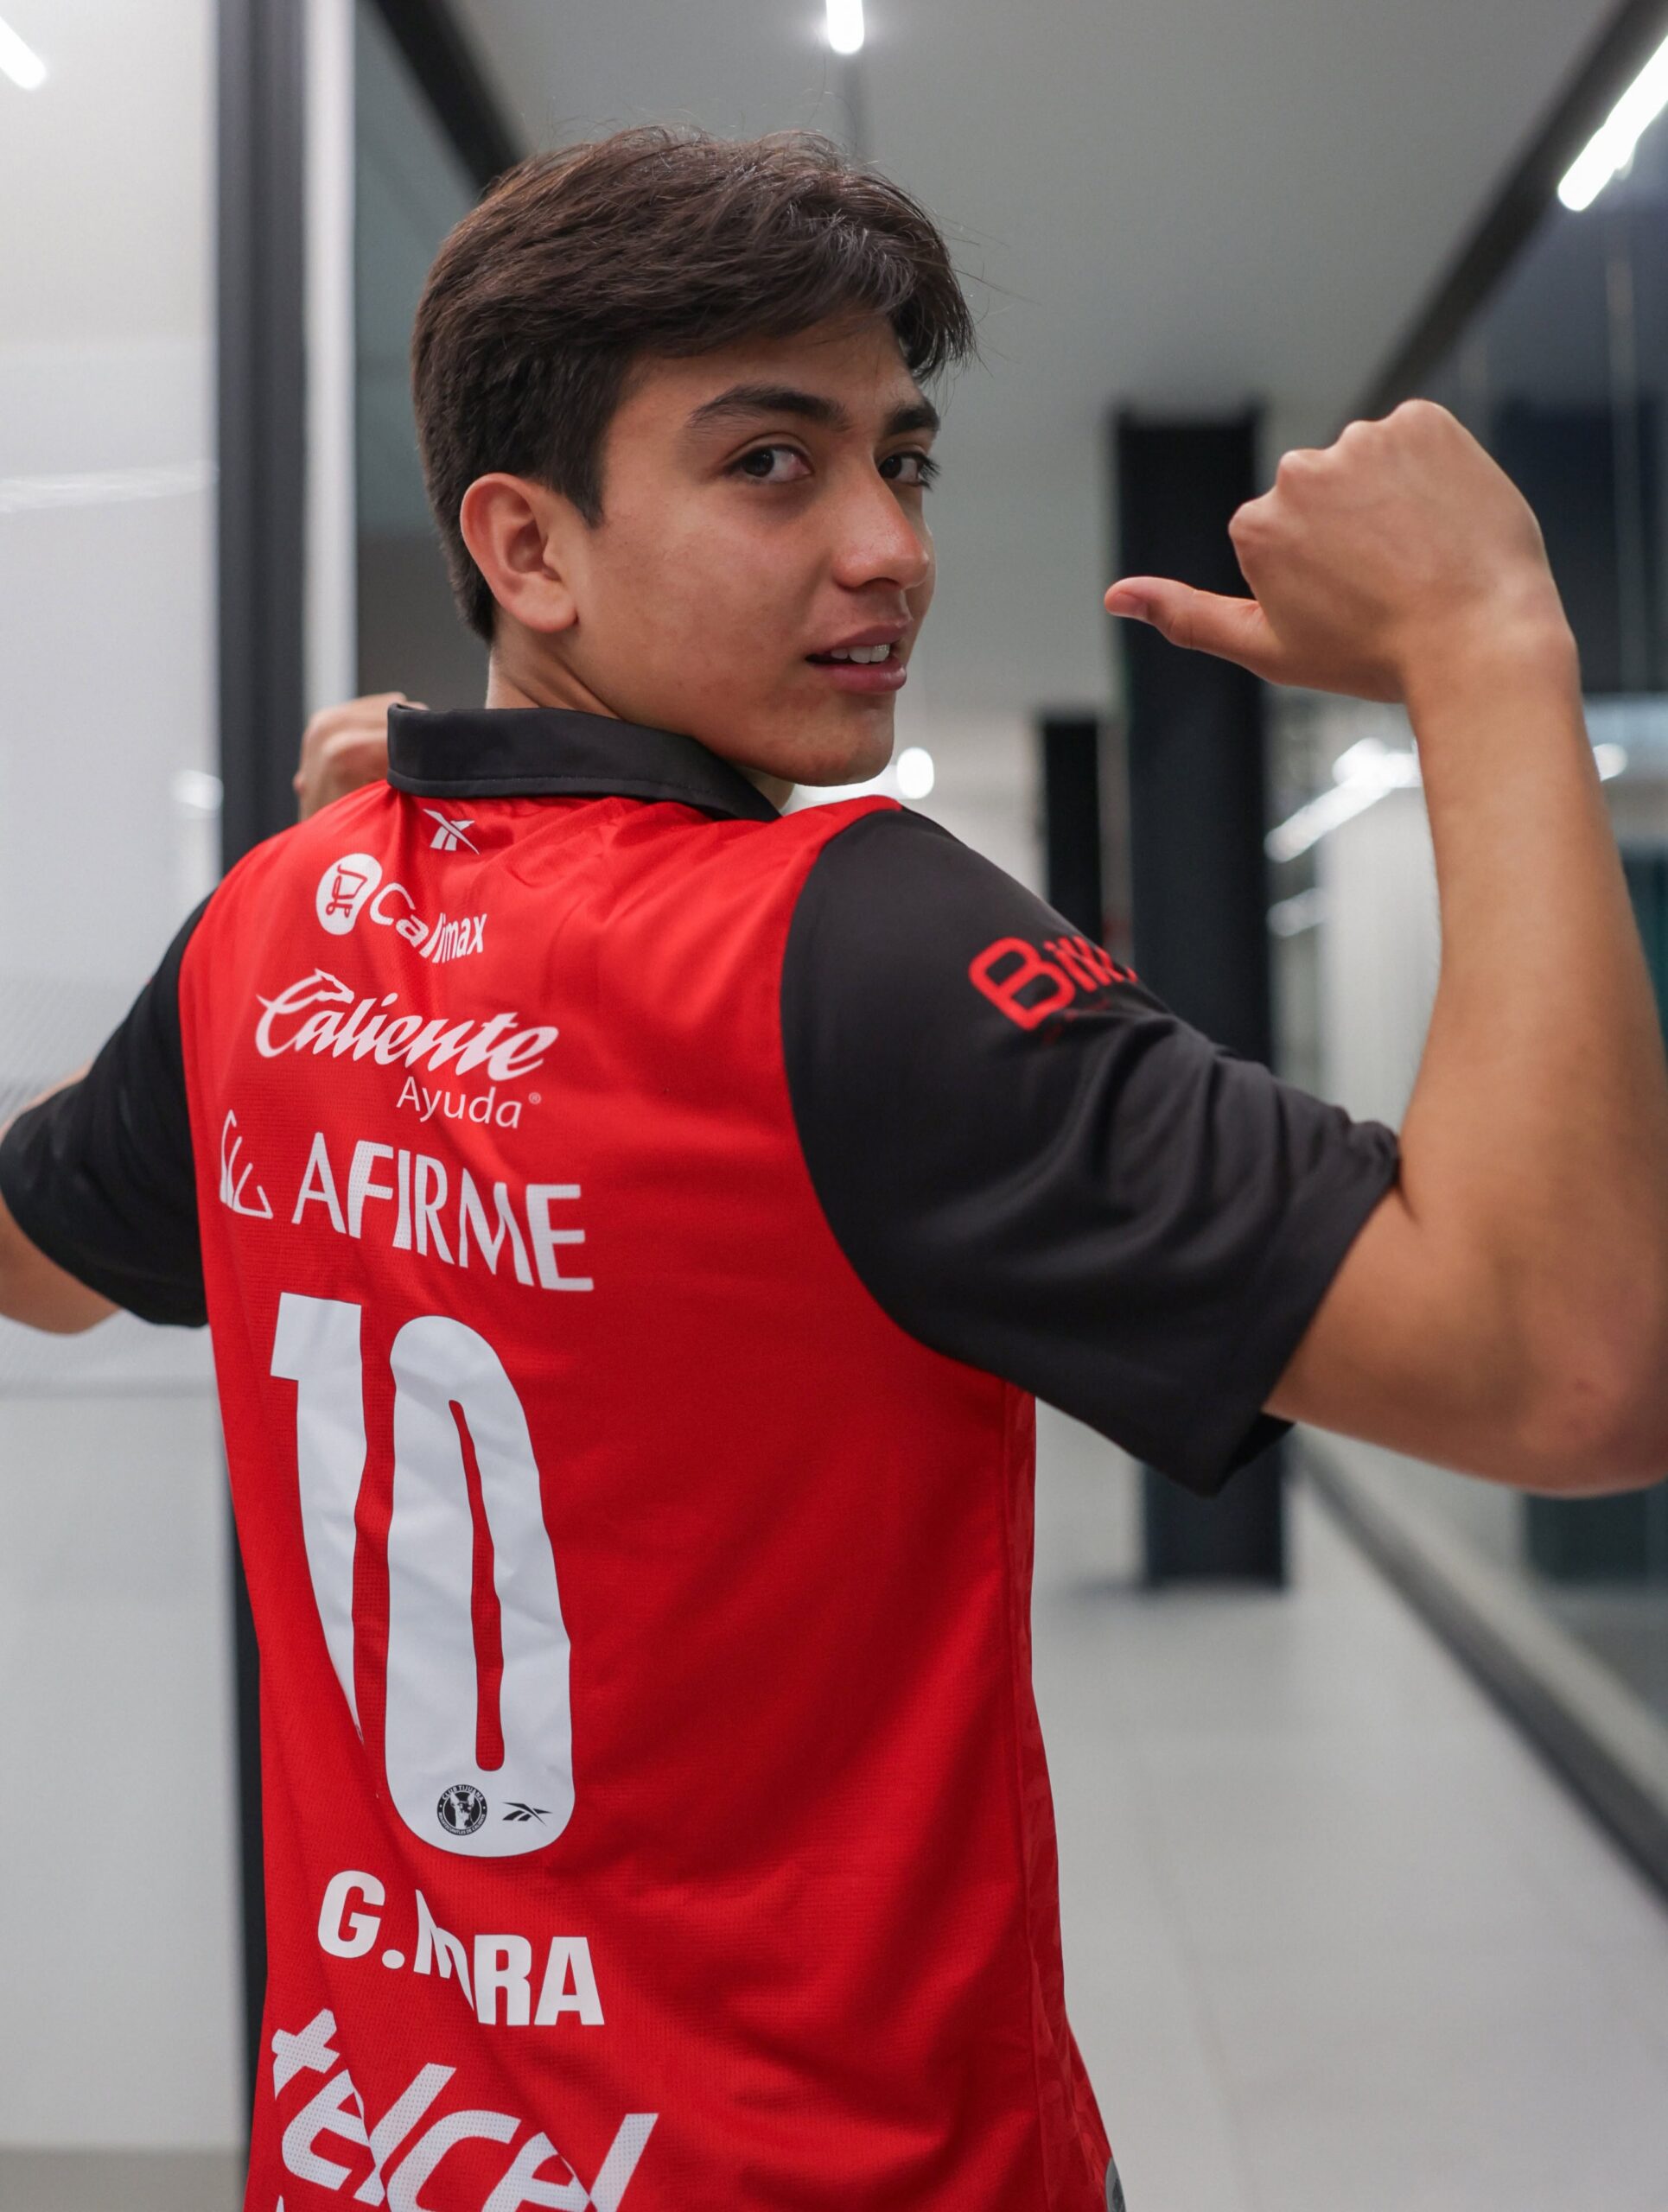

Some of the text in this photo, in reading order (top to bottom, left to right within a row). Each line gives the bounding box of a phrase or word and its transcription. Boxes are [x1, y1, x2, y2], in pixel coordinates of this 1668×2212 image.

[369, 881, 487, 963] Calimax
[254, 968, 559, 1081] Caliente
[396, 1076, 522, 1128] Ayuda
[291, 1132, 595, 1291] AFIRME
[270, 1292, 576, 1858] 10
[271, 2008, 659, 2212] telcel
